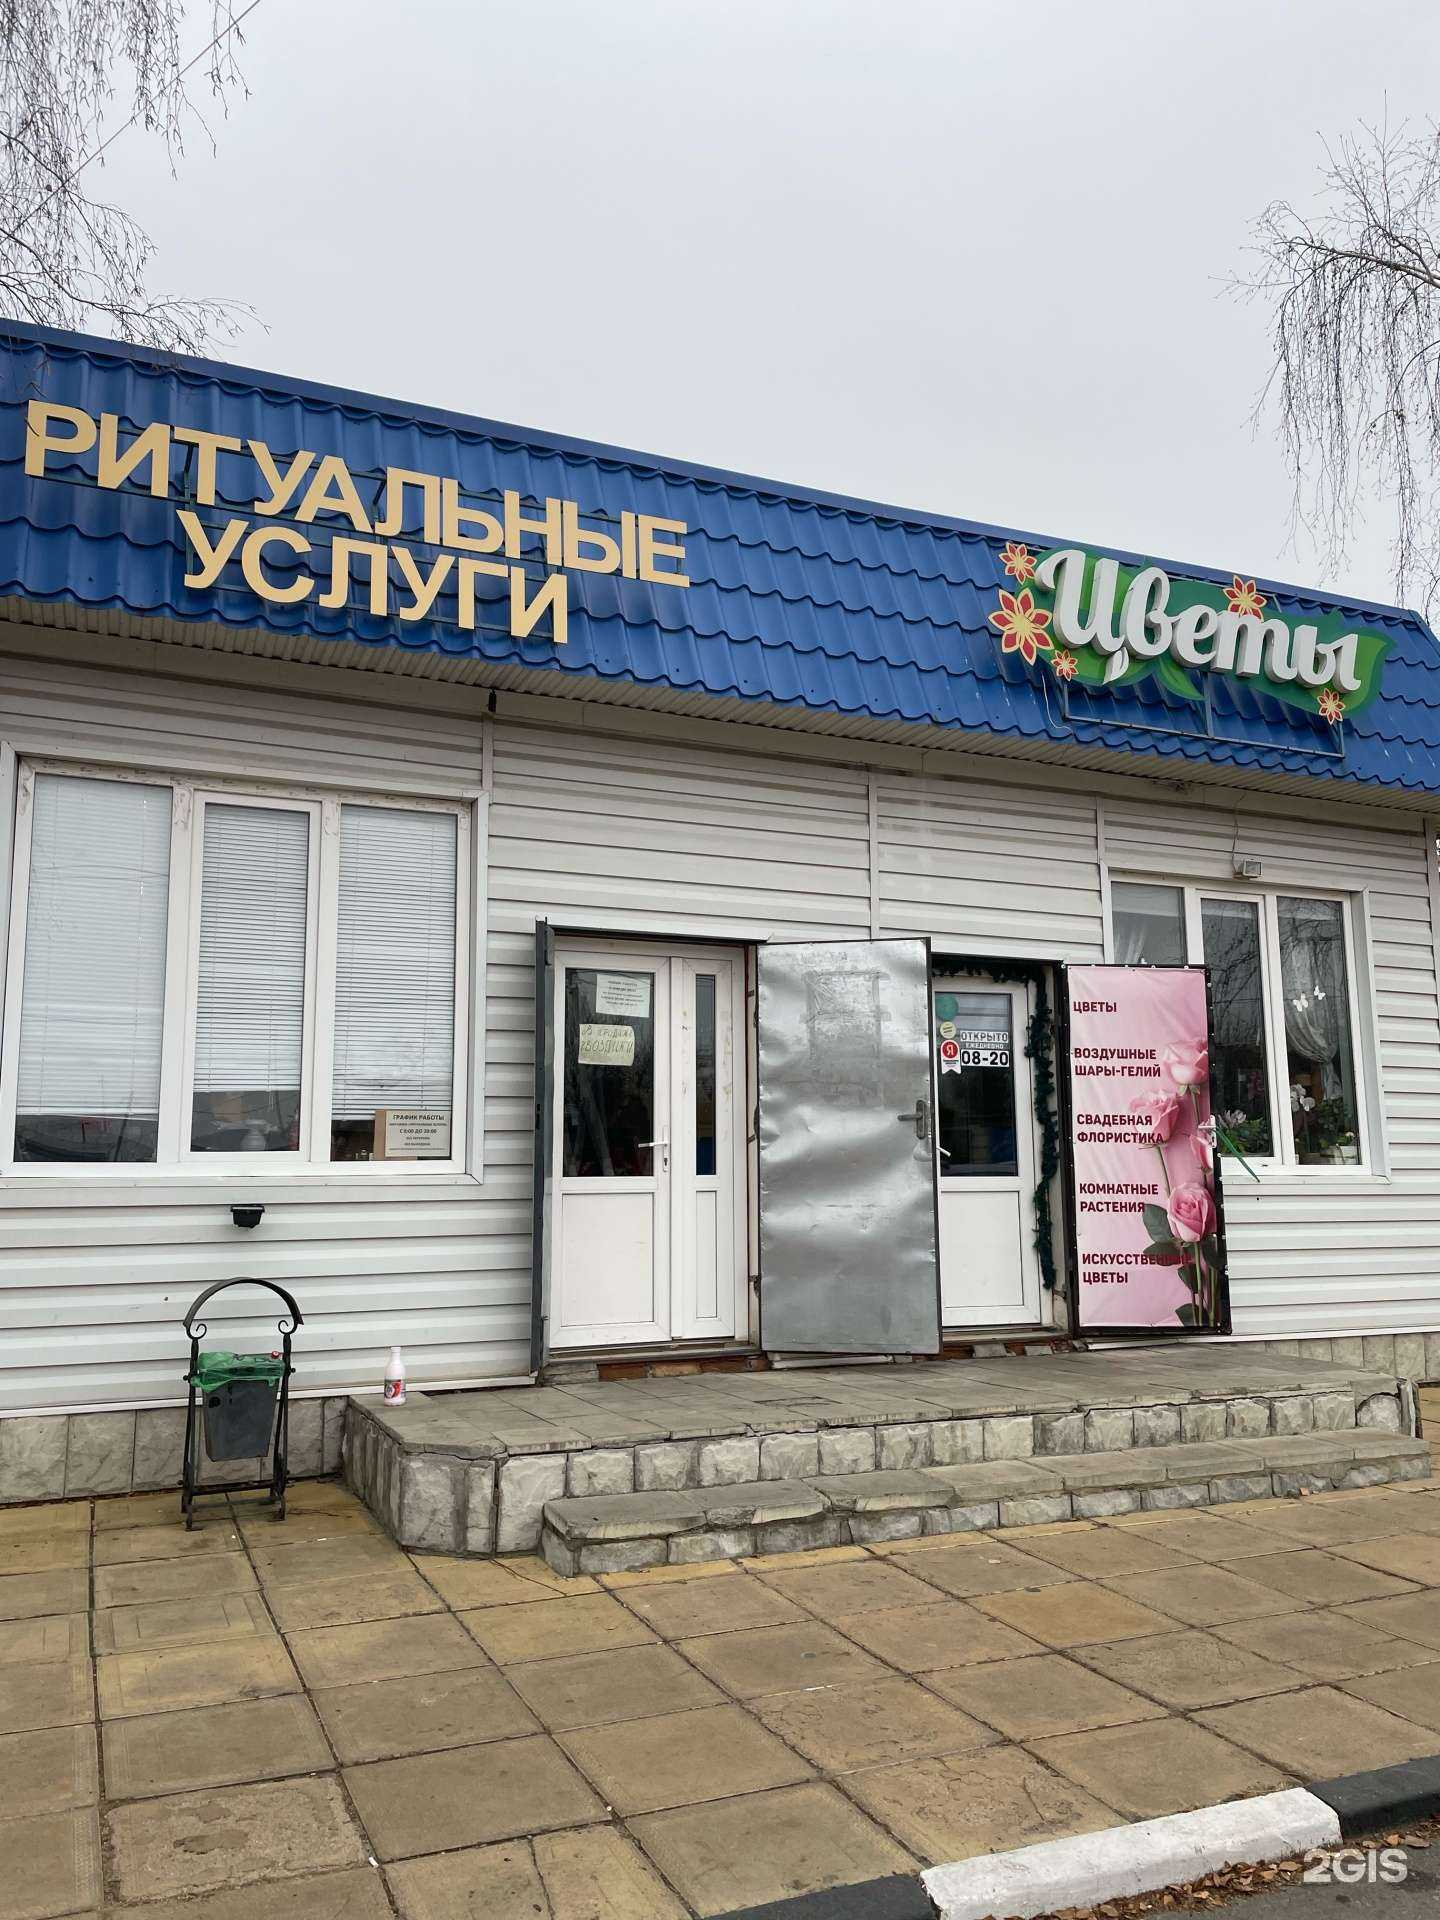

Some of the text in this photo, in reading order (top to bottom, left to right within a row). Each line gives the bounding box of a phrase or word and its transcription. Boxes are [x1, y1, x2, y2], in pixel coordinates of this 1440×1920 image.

[25, 399, 690, 588] РИТУАЛЬНЫЕ
[175, 508, 568, 645] УСЛУГИ
[1034, 548, 1362, 692] Цветы
[1073, 1001, 1117, 1014] ЦВЕТЫ
[961, 1031, 1008, 1042] ОТКРЫТО
[962, 1050, 1008, 1065] 08-20
[1074, 1047, 1157, 1060] ВОЗДУШНЫЕ
[1075, 1064, 1161, 1077] ШАРЫ-ГЕЛИЙ
[1077, 1113, 1153, 1127] СВАДЕБНАЯ
[1077, 1131, 1164, 1144] ФЛОРИСТИКА
[1079, 1183, 1159, 1195] КОМНАТНЫЕ
[1080, 1201, 1145, 1213] РАСТЕНИЯ
[1083, 1271, 1128, 1285] ЦВЕТЫ
